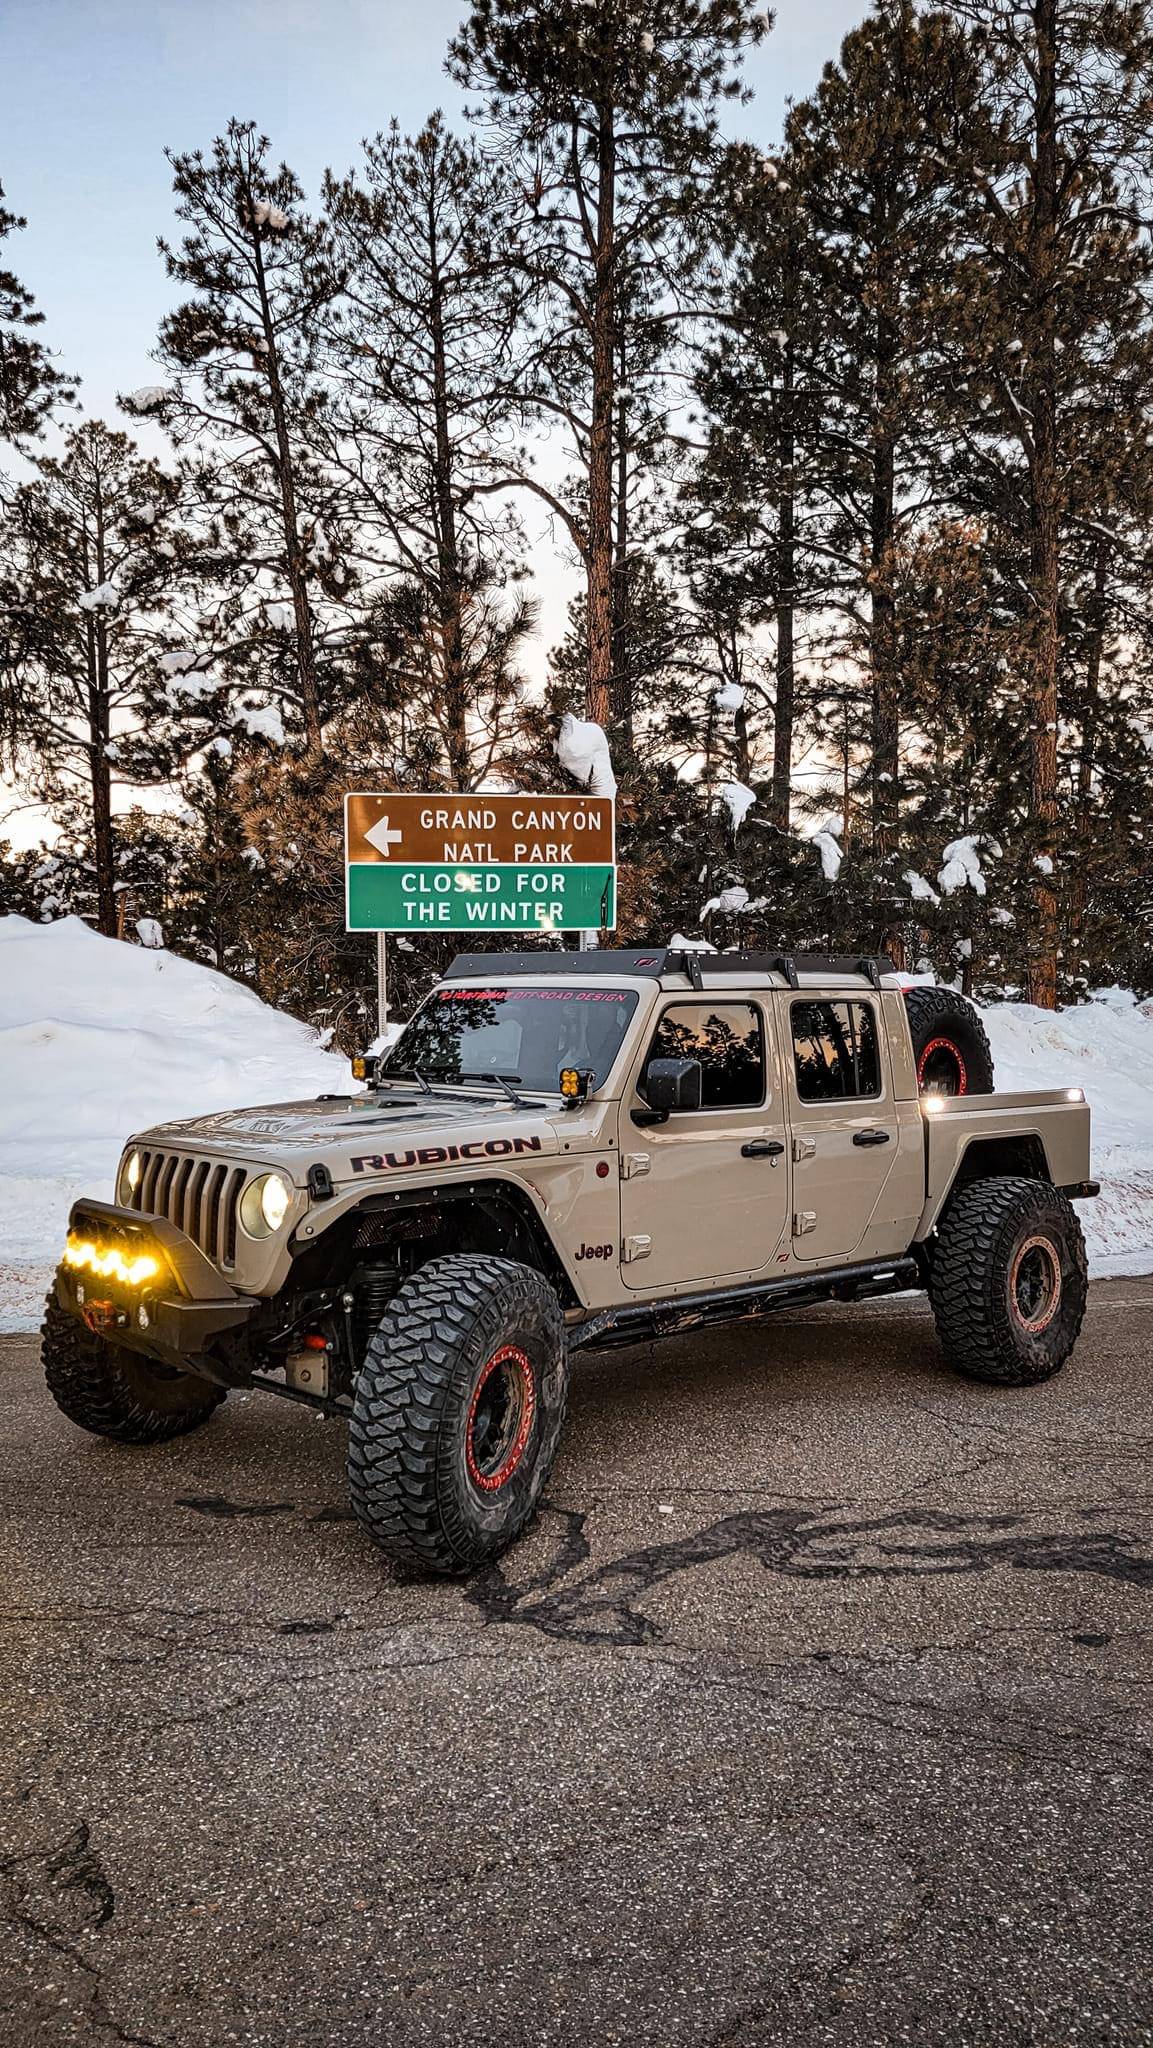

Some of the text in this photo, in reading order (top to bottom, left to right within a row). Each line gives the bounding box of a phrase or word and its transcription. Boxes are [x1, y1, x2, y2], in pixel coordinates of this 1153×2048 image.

[420, 809, 602, 831] GRAND CANYON
[443, 843, 573, 863] NATL PARK
[400, 873, 566, 893] CLOSED FOR
[403, 901, 564, 921] THE WINTER
[575, 992, 628, 1002] DESIGN
[350, 1135, 542, 1173] RUBICON
[574, 1242, 614, 1262] Jeep
